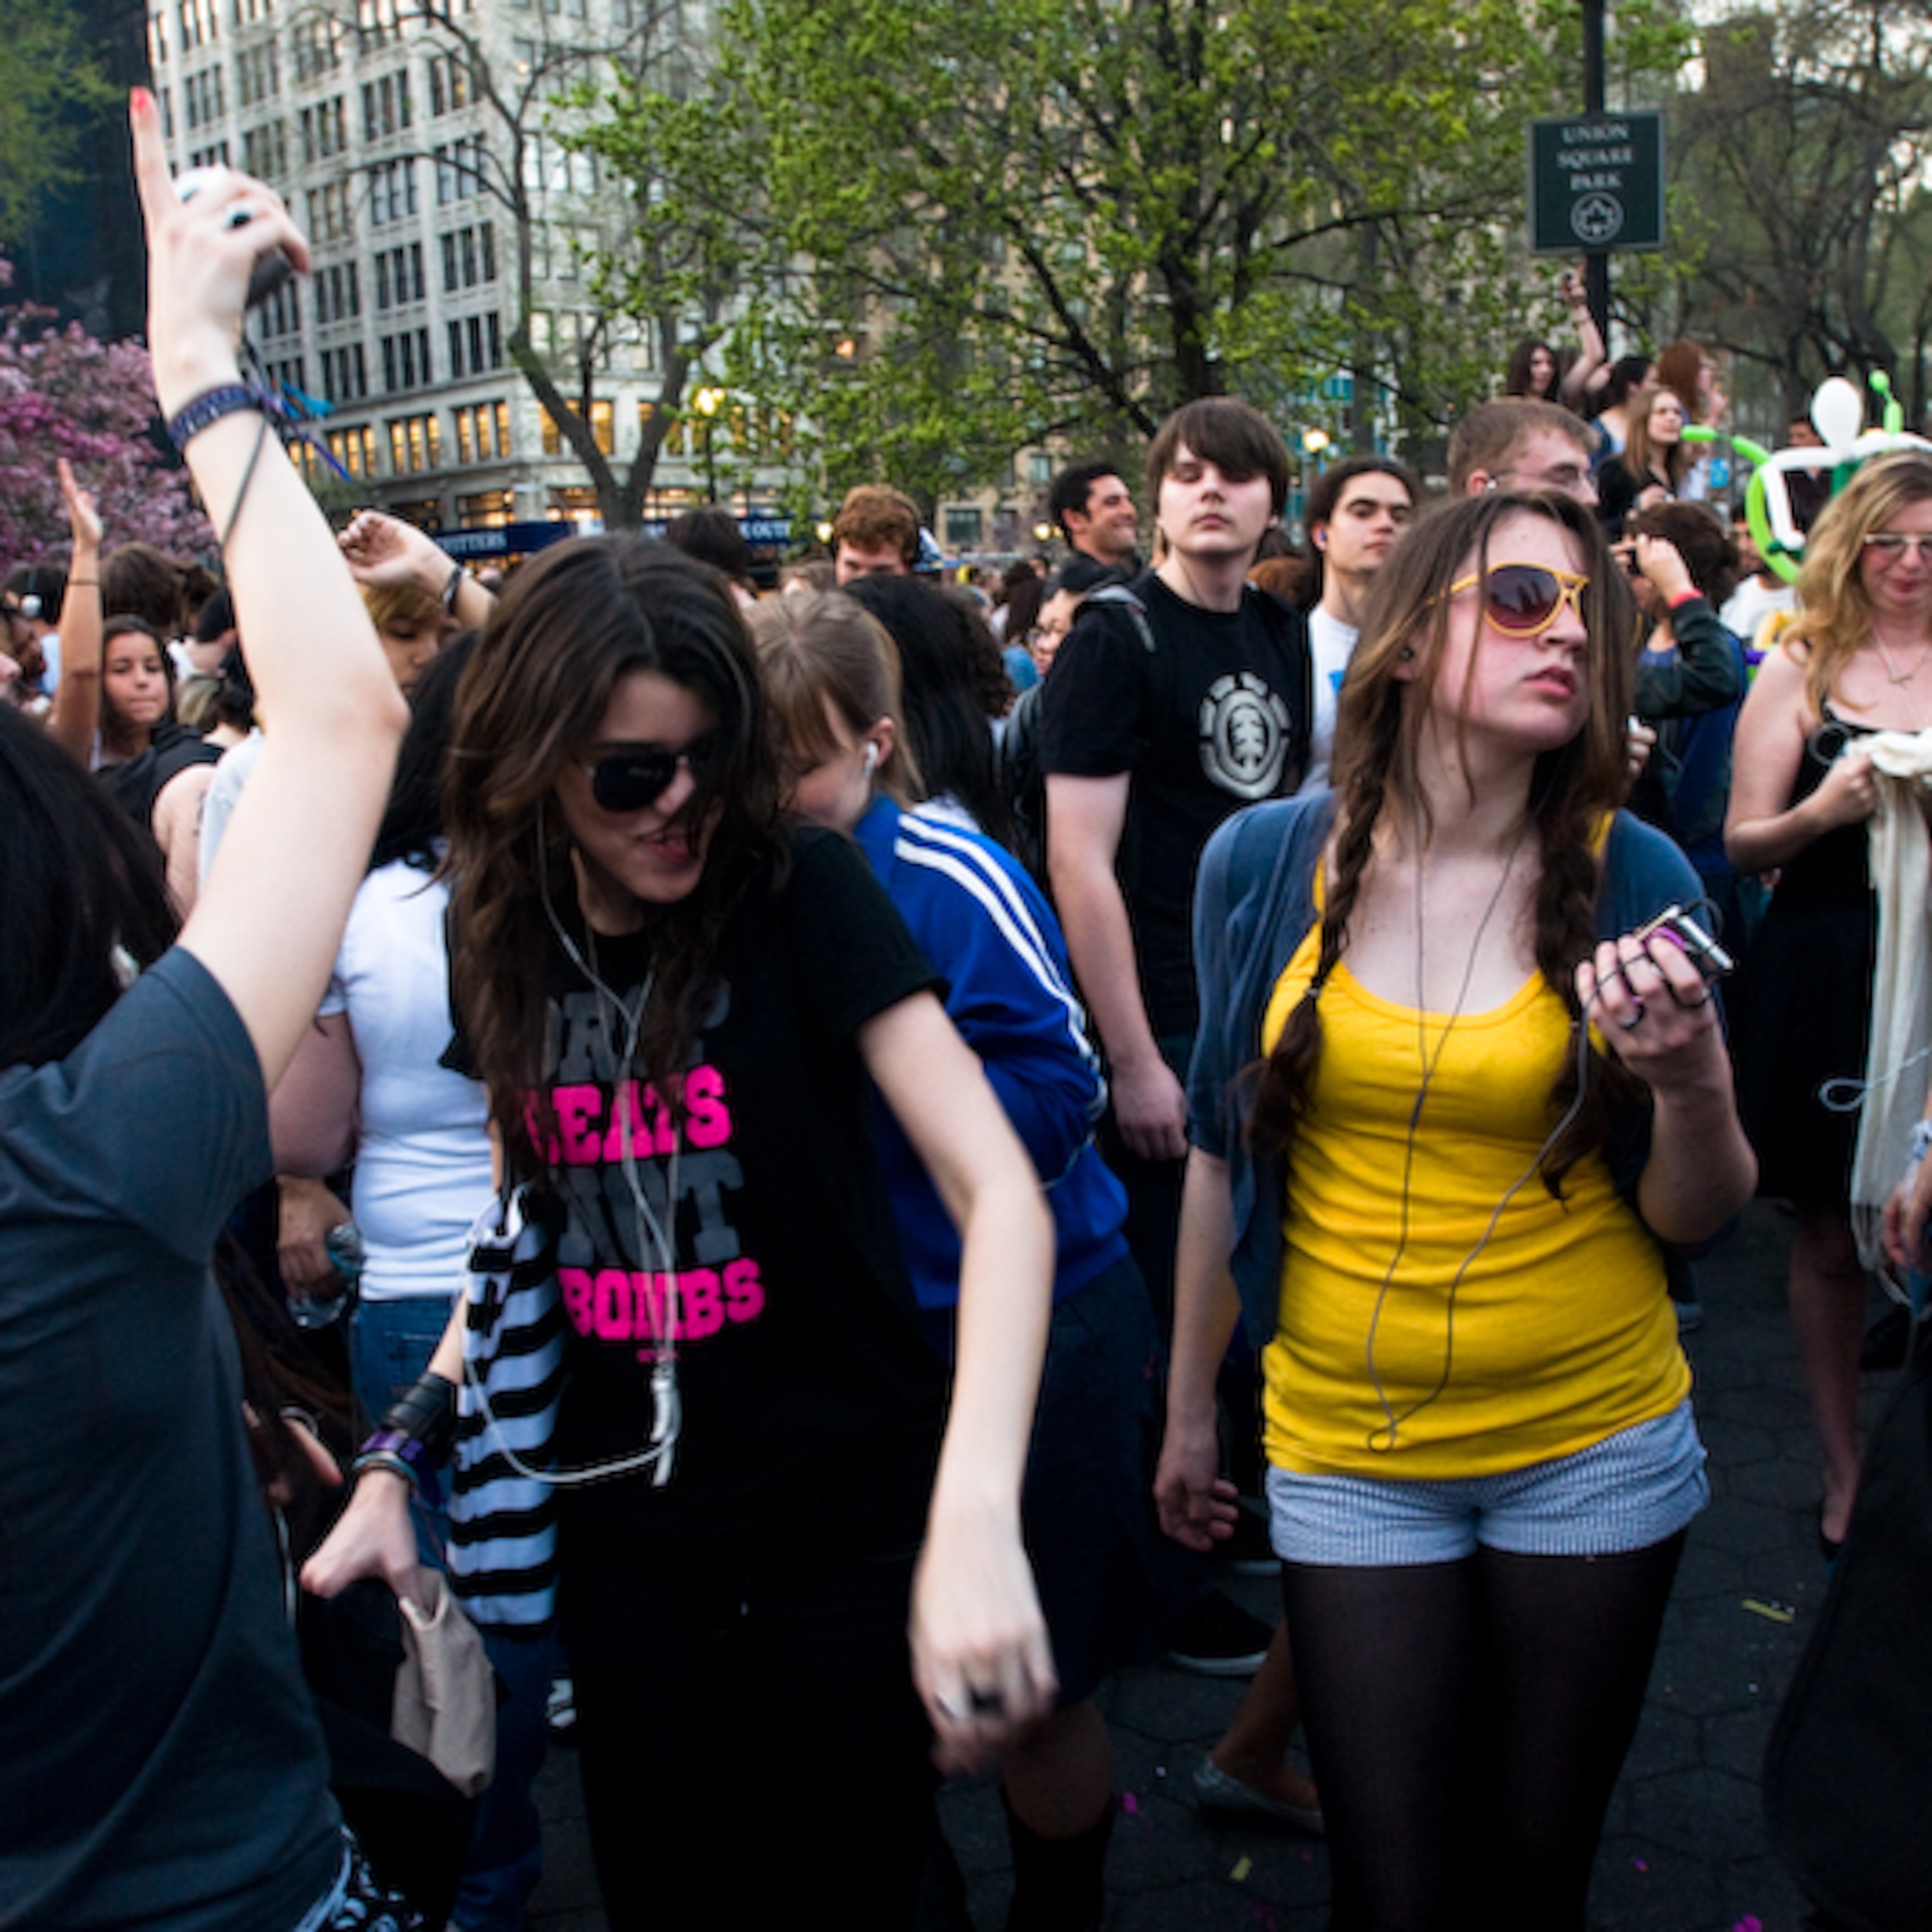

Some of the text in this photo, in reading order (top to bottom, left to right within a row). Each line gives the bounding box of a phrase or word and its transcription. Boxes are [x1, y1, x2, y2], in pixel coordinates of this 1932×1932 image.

[1562, 123, 1629, 143] UNION
[1557, 146, 1633, 169] SQUARE
[1570, 173, 1622, 191] PARK
[549, 1150, 745, 1273] NOT
[556, 1256, 766, 1341] BOMBS
